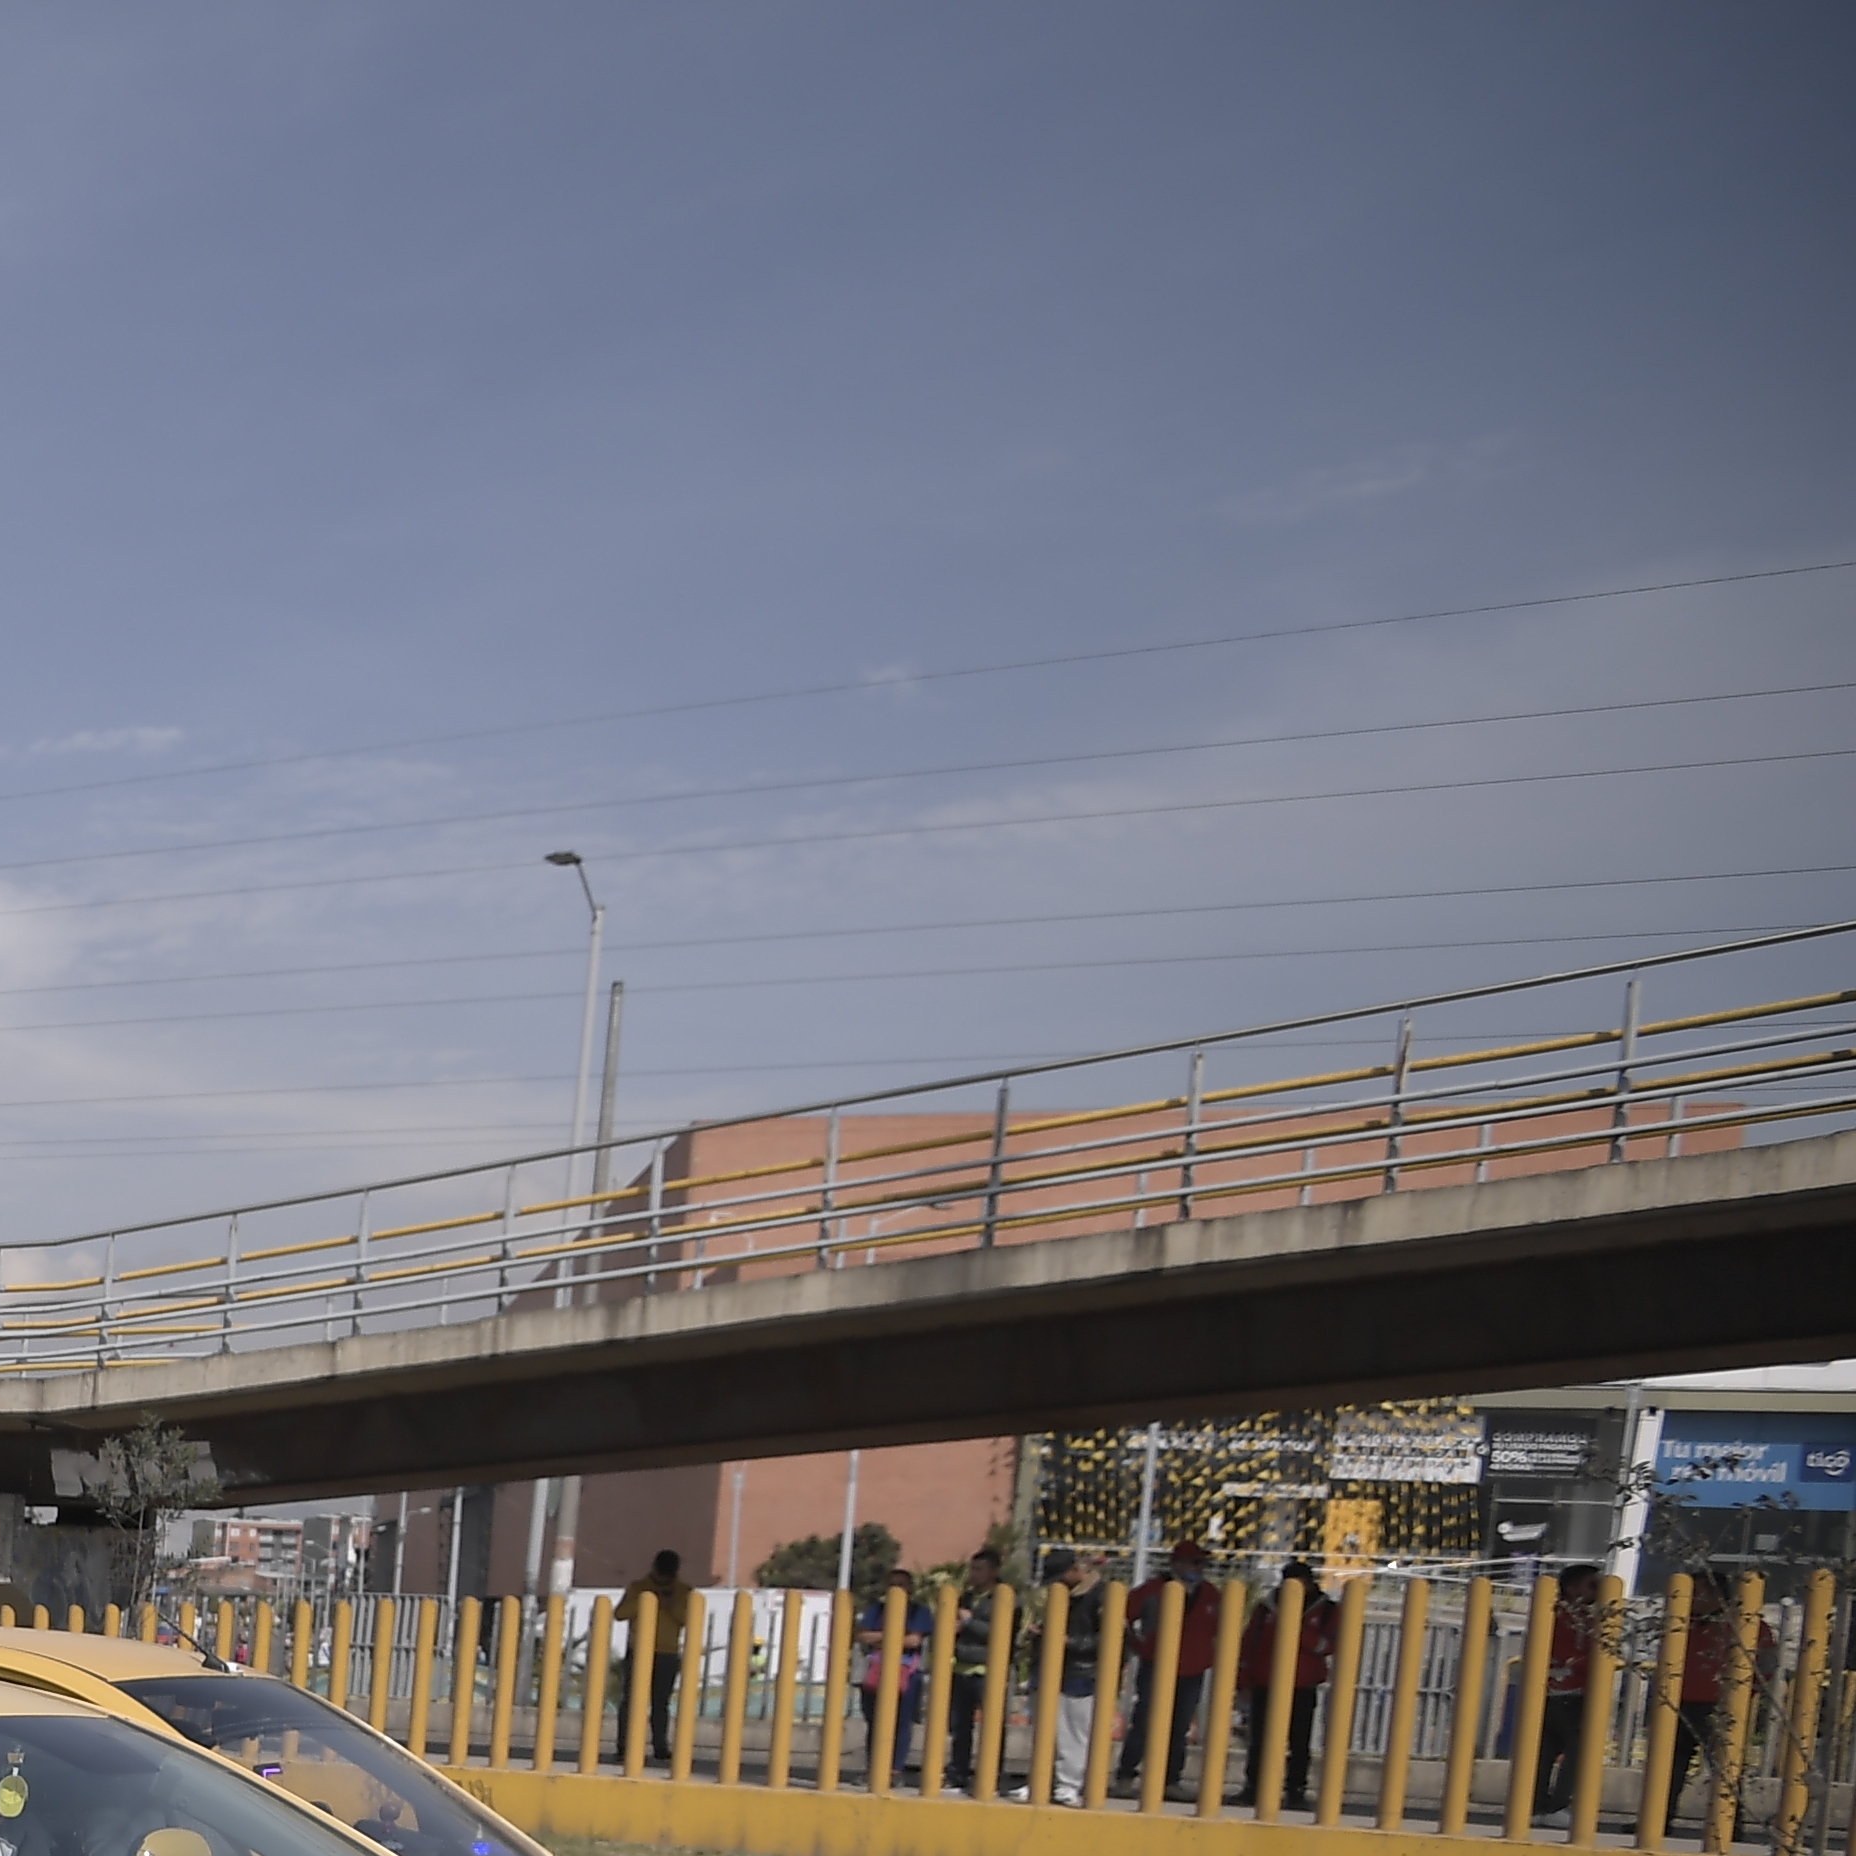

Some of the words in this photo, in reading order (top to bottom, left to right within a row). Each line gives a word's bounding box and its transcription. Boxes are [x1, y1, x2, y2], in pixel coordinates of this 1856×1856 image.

[1490, 1450, 1528, 1463] 50%
[1663, 1440, 1691, 1459] Tu
[1693, 1440, 1770, 1462] mejor
[1717, 1462, 1789, 1484] móvil
